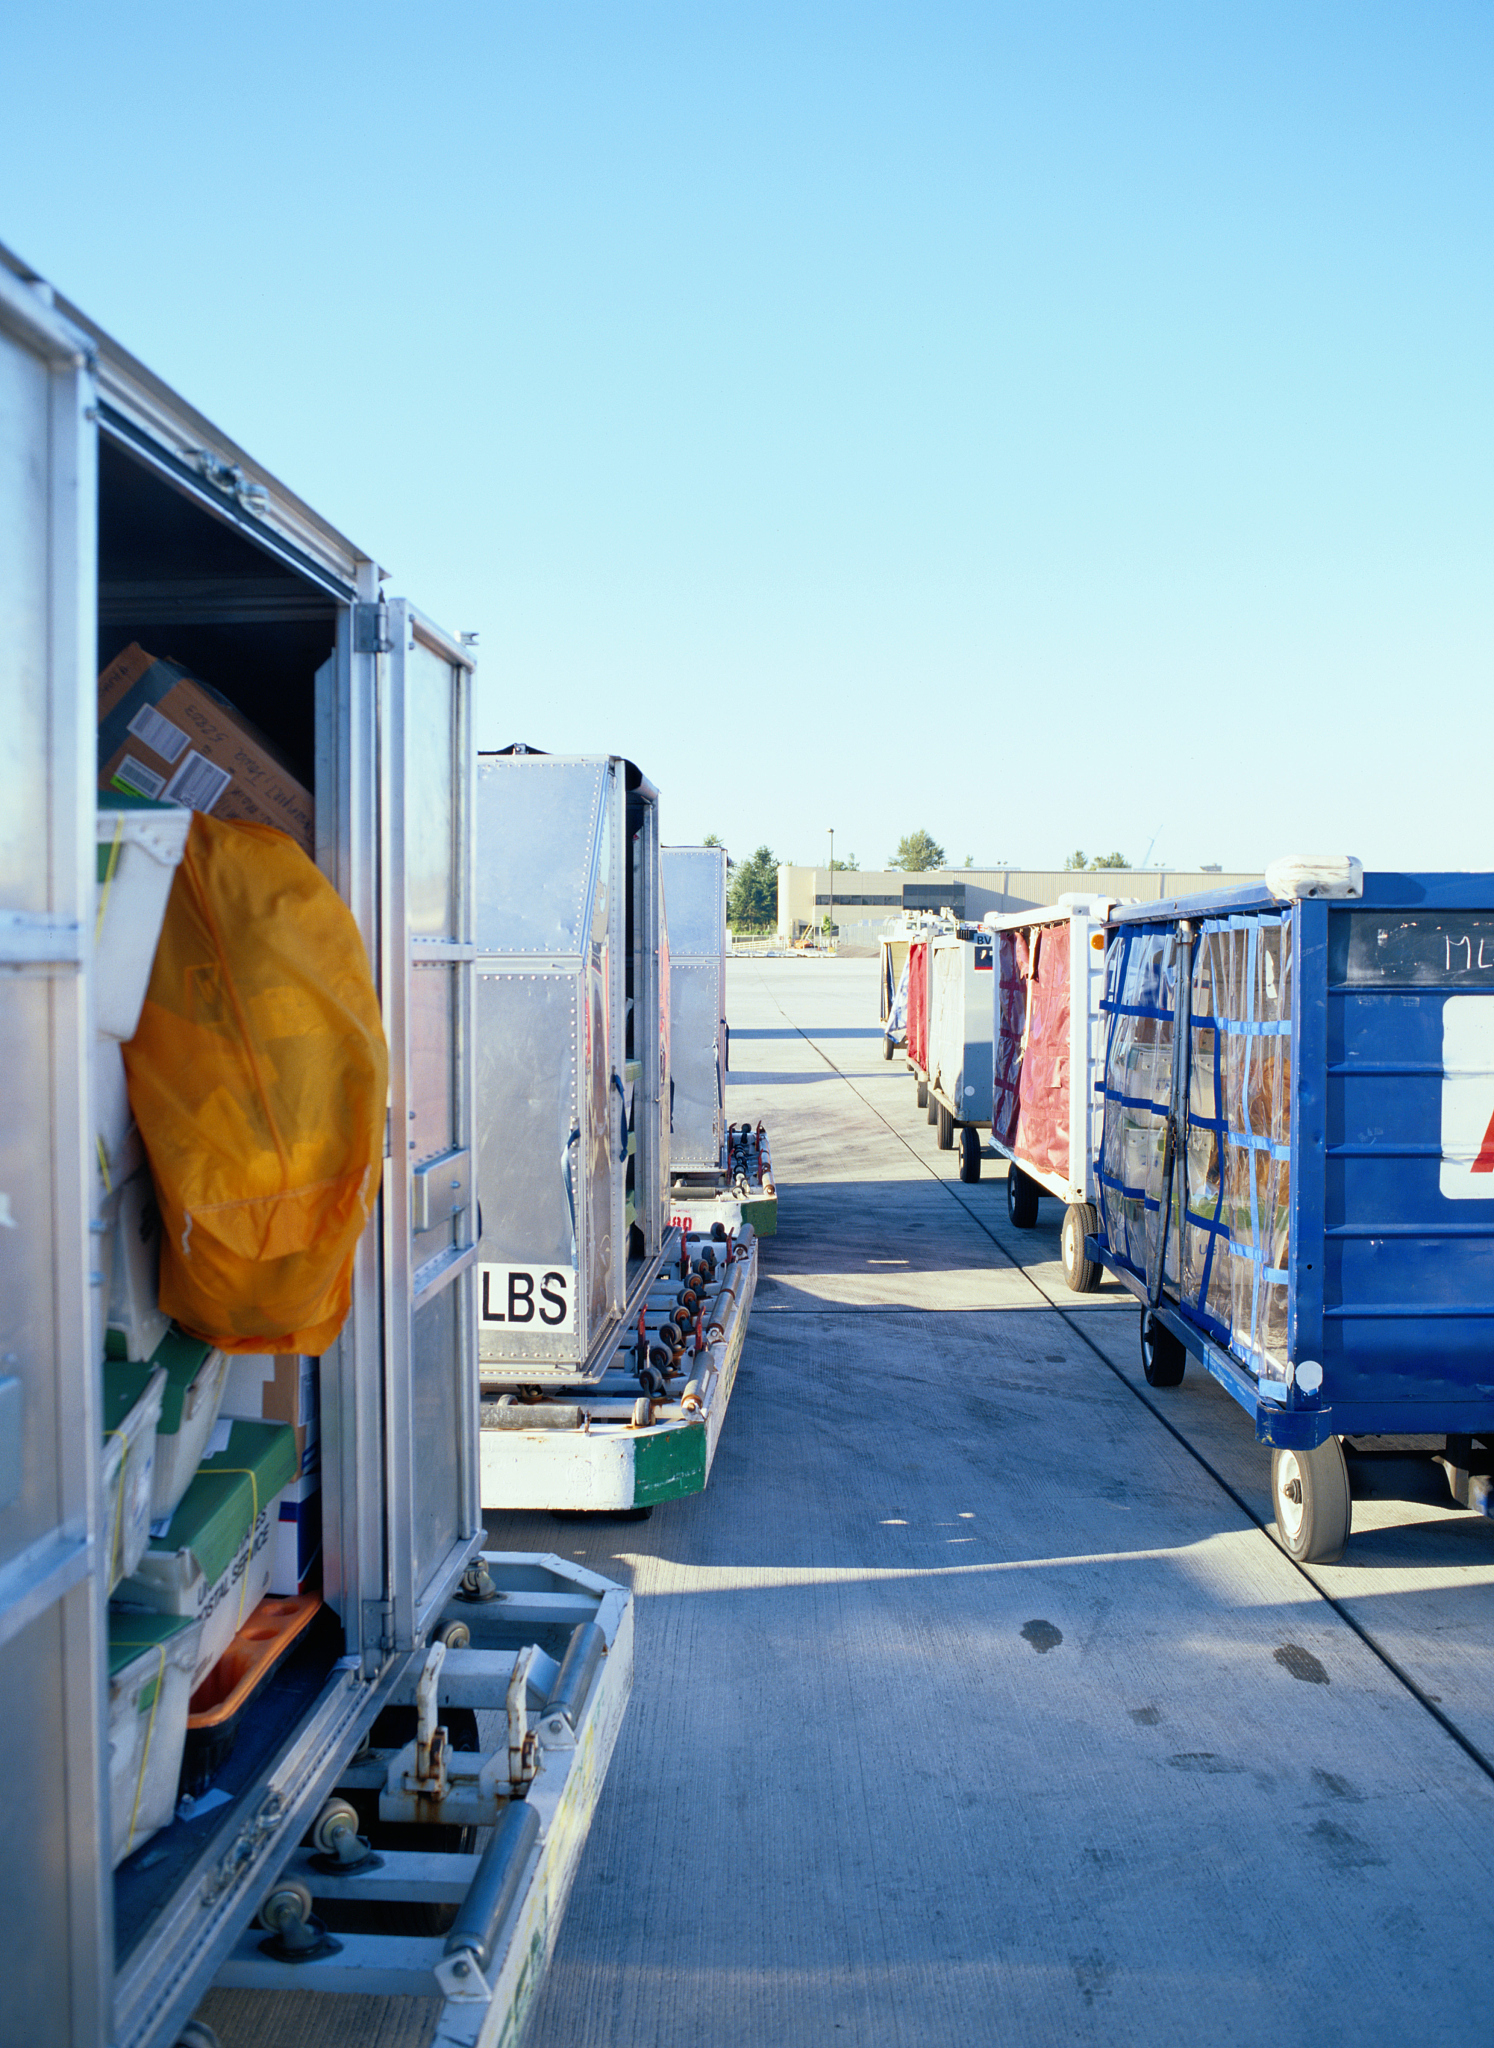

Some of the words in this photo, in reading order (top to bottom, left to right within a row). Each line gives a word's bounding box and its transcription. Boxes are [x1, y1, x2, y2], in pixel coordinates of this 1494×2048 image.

[1445, 934, 1494, 971] ML
[667, 1216, 693, 1231] 80
[482, 1271, 567, 1326] LBS
